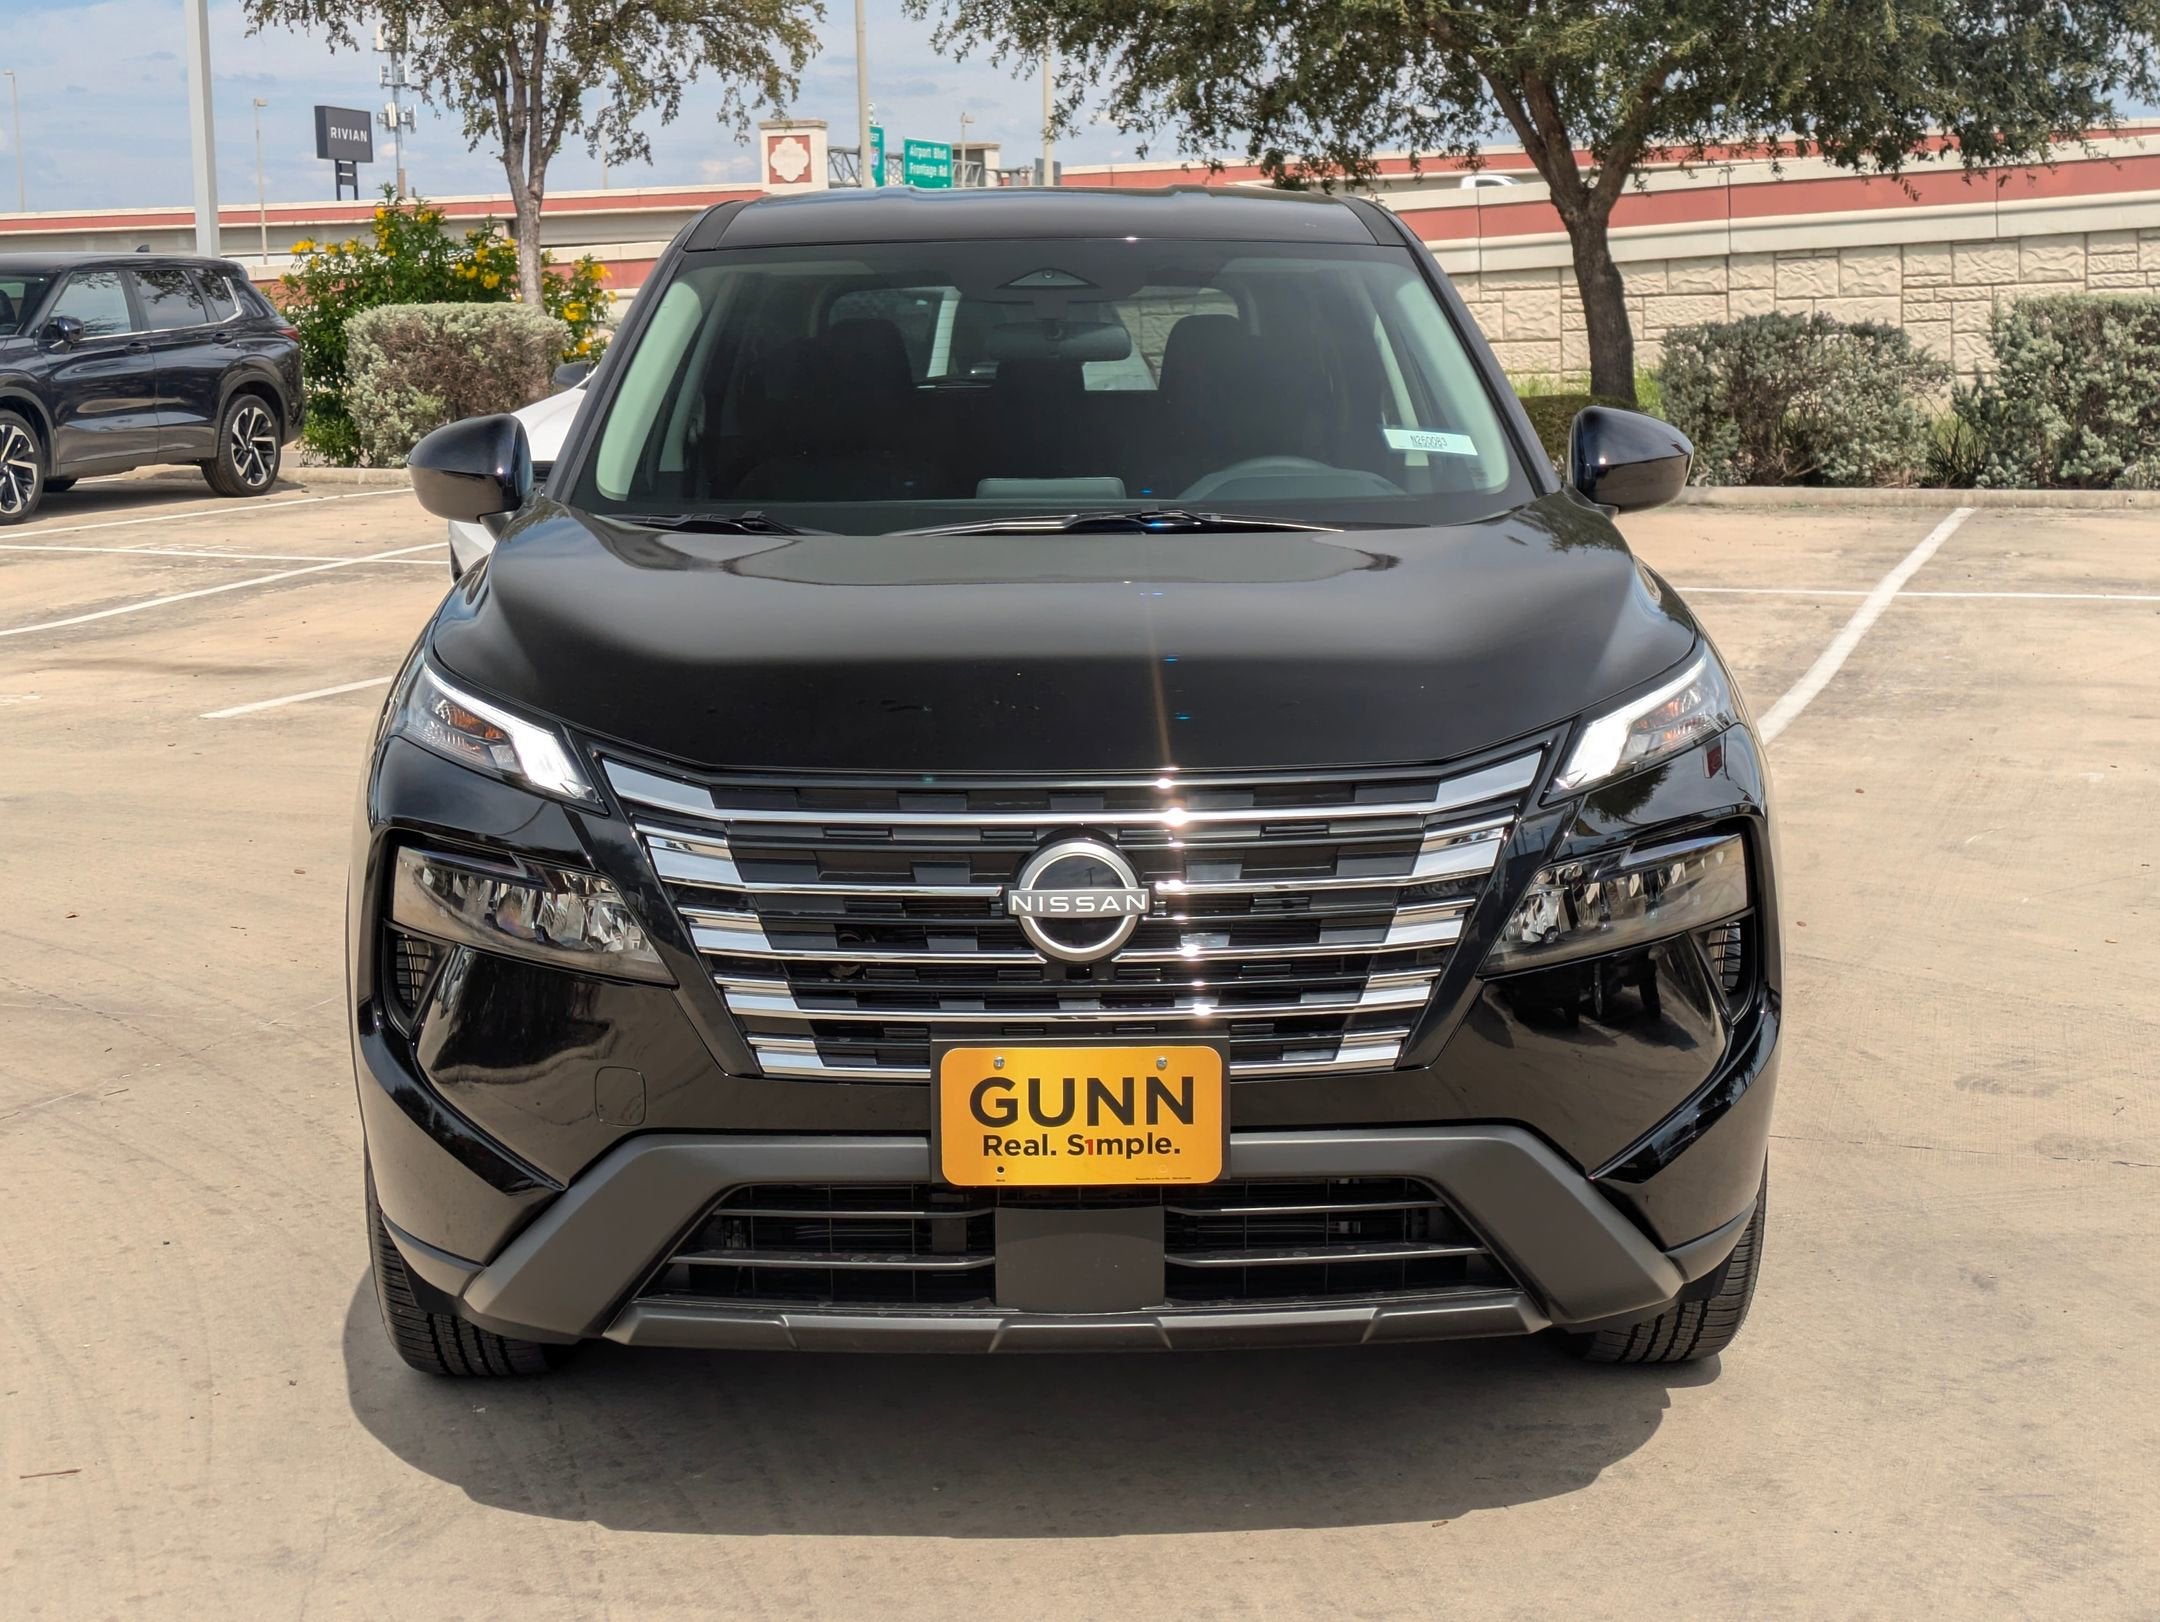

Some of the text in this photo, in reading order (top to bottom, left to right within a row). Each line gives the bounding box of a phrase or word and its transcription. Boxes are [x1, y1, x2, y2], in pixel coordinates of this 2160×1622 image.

[330, 127, 368, 142] RIVIAN
[909, 144, 948, 160] Airport Blvd
[909, 162, 937, 178] Frontage
[1011, 894, 1146, 912] NISSAN
[969, 1076, 1194, 1128] GUNN
[982, 1133, 1057, 1157] Real.
